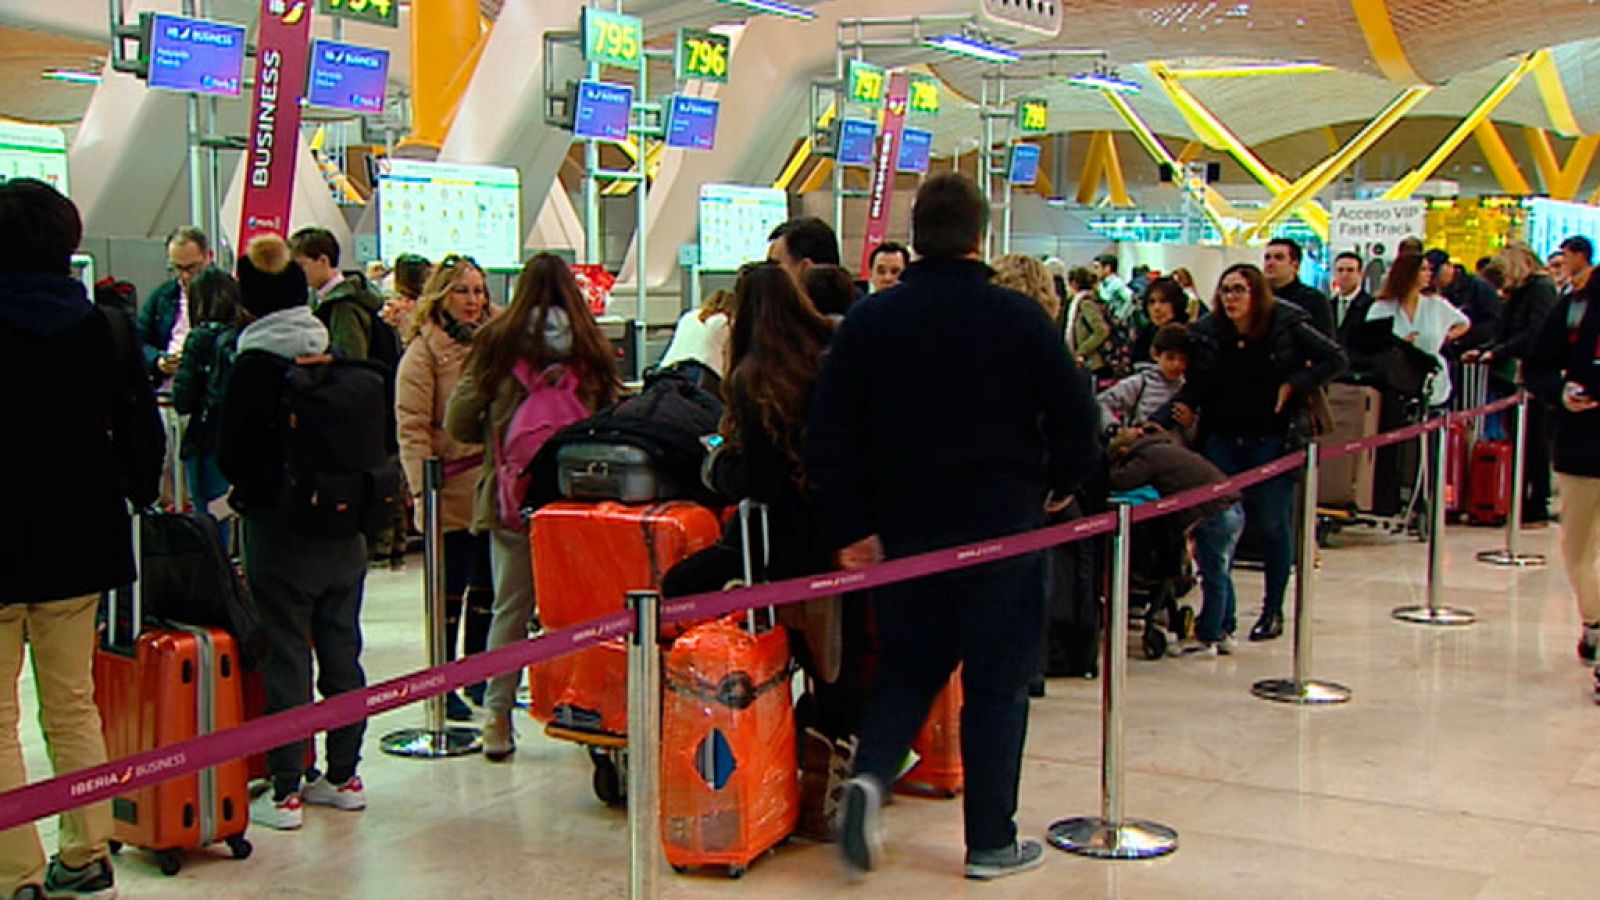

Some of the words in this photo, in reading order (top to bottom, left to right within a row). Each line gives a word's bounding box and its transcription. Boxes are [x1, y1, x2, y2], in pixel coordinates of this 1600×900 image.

[594, 18, 638, 59] 795
[686, 39, 726, 76] 796
[252, 50, 281, 187] BUSINESS
[1338, 206, 1391, 219] Acceso
[1393, 206, 1418, 218] VIP
[1340, 222, 1370, 236] Fast
[1374, 222, 1412, 235] Track
[71, 772, 118, 797] IBERIA
[135, 752, 187, 777] BUSINESS
